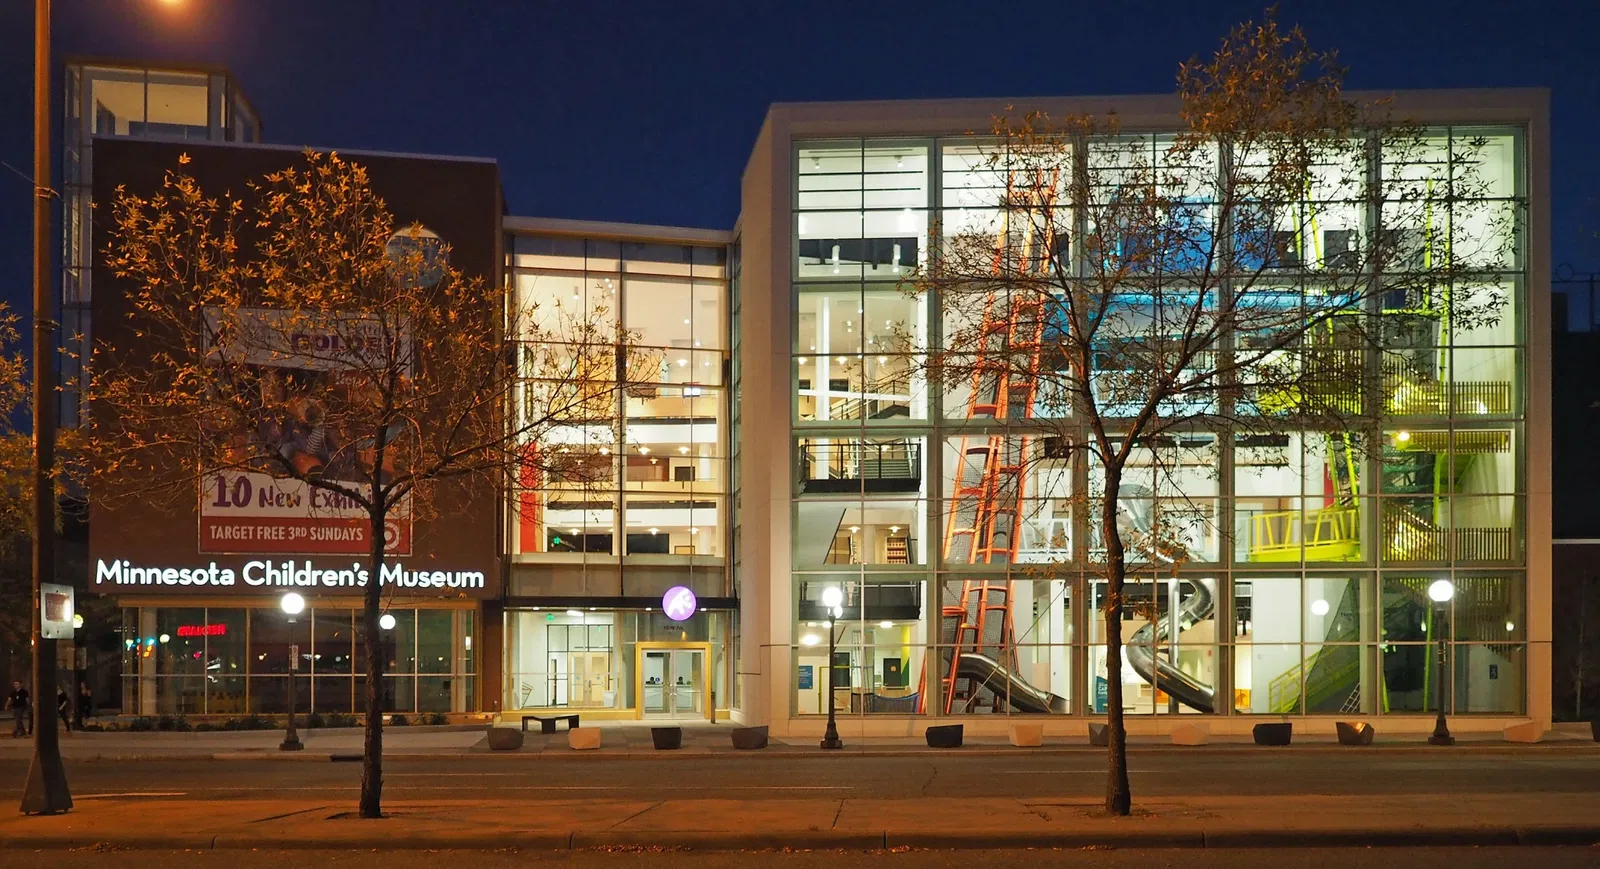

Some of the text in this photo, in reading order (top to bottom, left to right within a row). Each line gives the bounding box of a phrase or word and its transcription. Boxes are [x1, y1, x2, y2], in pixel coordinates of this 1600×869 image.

[212, 475, 253, 508] 10
[258, 485, 301, 508] New
[209, 525, 363, 541] TARGET FREE 3RD SUNDAYS
[95, 558, 484, 588] Minnesota Children's Museum
